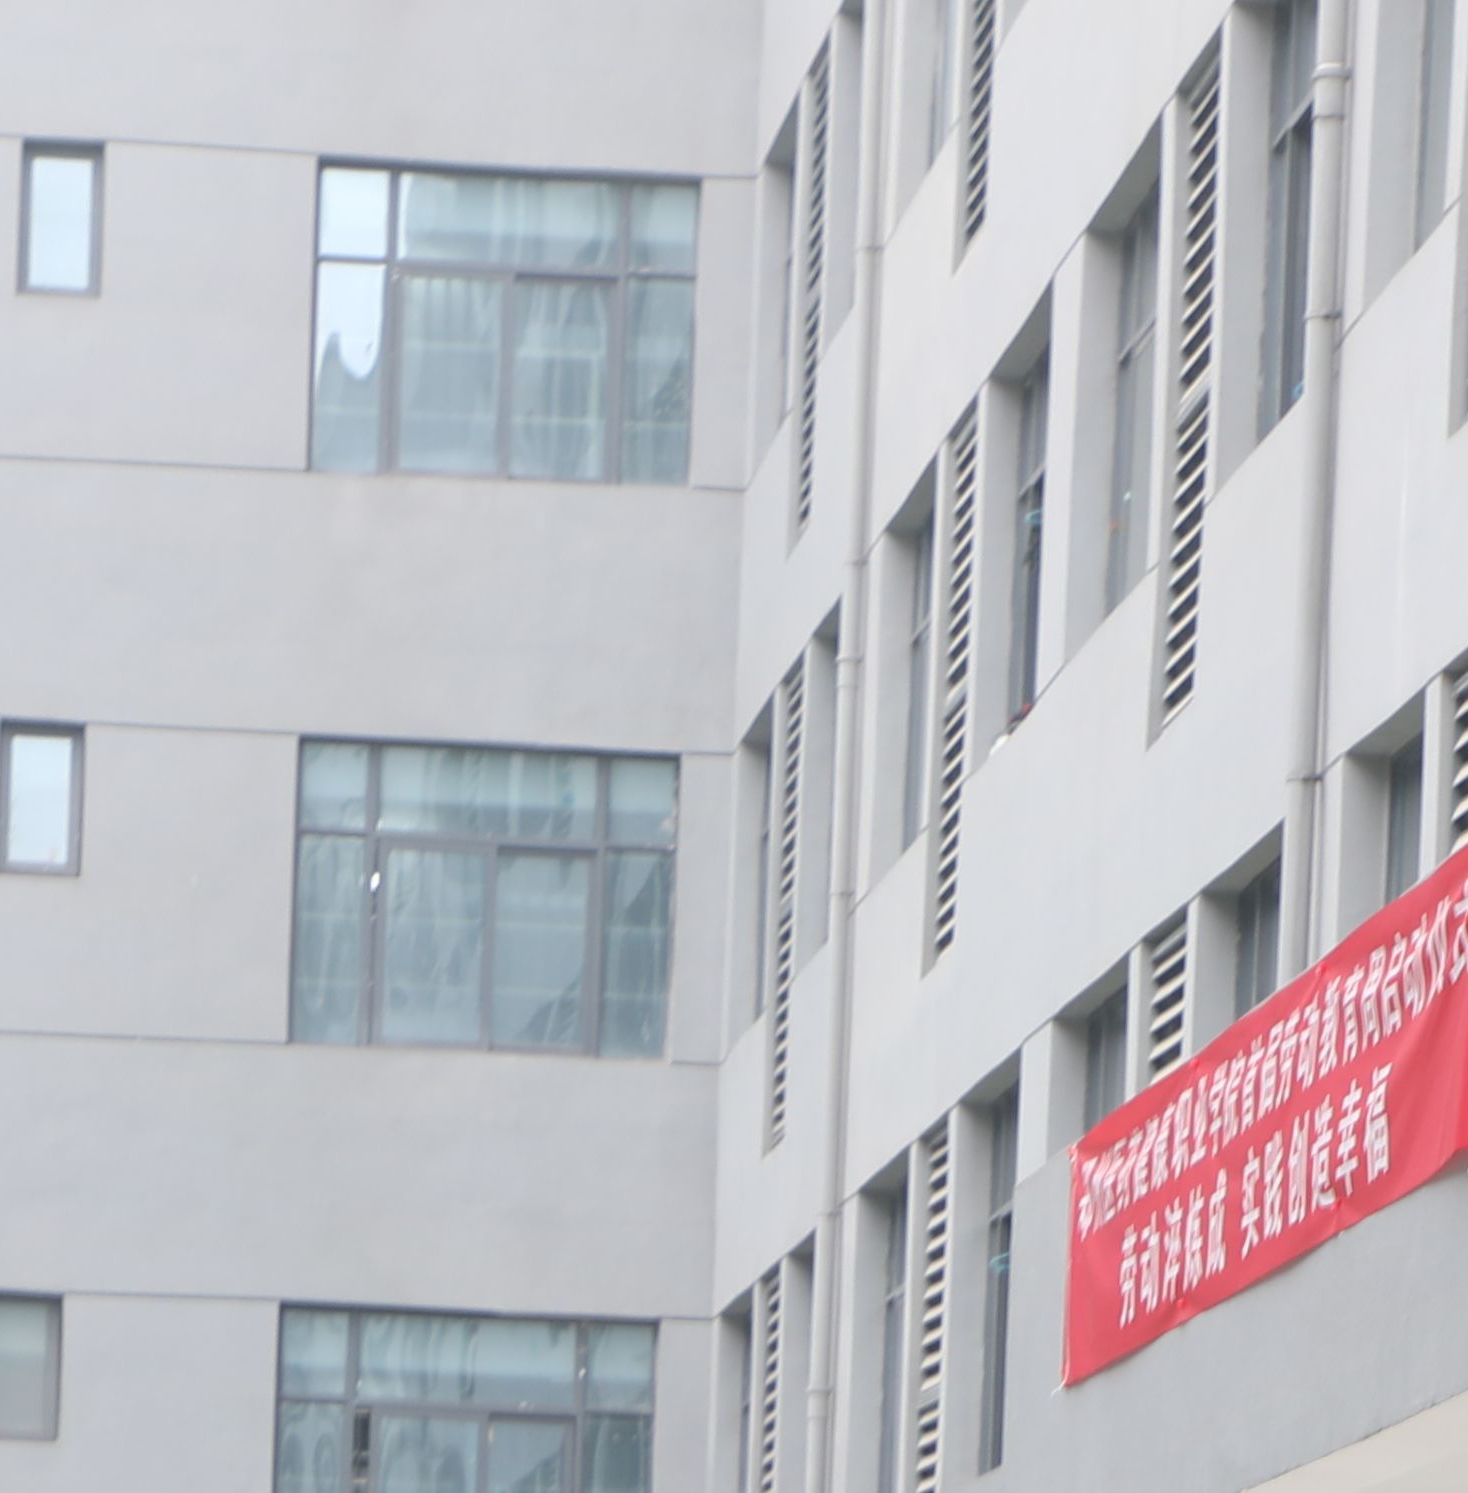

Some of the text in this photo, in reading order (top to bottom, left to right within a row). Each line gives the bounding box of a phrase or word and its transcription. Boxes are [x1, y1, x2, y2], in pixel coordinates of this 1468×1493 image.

[1241, 1062, 1393, 1259] 实践创造幸福
